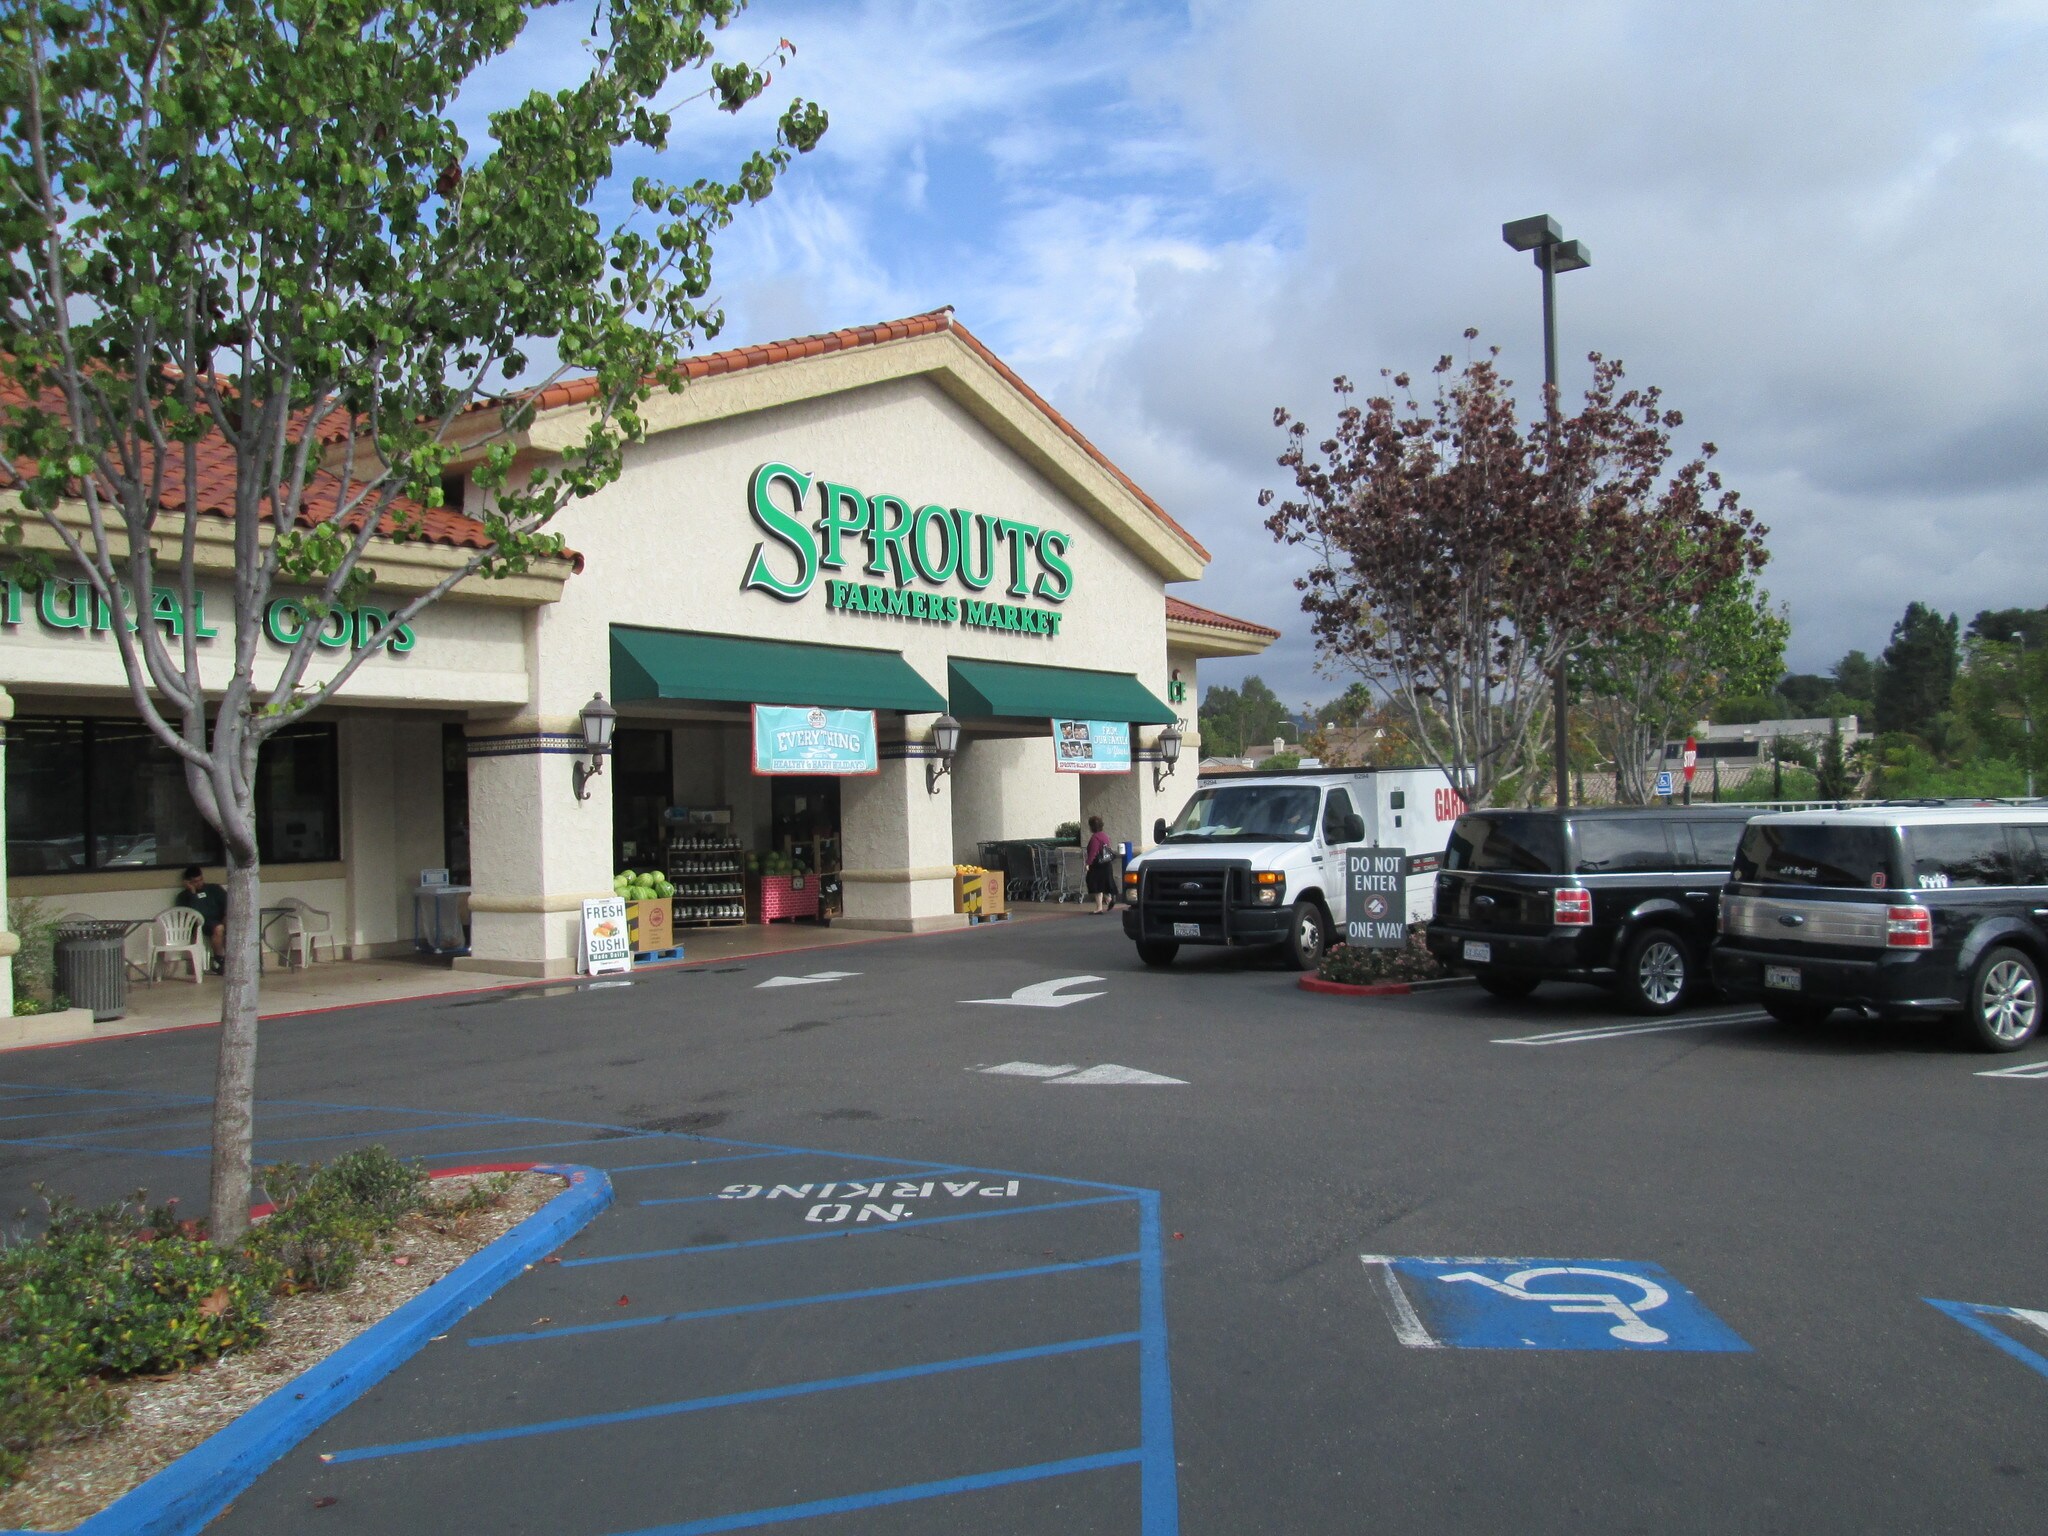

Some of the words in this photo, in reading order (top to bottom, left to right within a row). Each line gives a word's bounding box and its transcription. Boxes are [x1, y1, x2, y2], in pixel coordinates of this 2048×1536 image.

[740, 461, 1074, 601] SPROUTS
[827, 579, 959, 622] FARMERS
[962, 599, 1062, 637] MARKET
[777, 730, 860, 752] EVERYTHING
[1684, 750, 1696, 768] STOP
[1351, 856, 1370, 873] DO
[1375, 856, 1401, 873] NOT
[1355, 875, 1397, 891] ENTER
[586, 905, 623, 919] FRESH
[1349, 922, 1373, 938] ONE
[1377, 923, 1403, 938] WAY
[591, 938, 626, 952] SUSHI
[610, 951, 625, 959] Daily
[718, 1180, 1019, 1199] PARKING
[805, 1203, 904, 1223] NO
